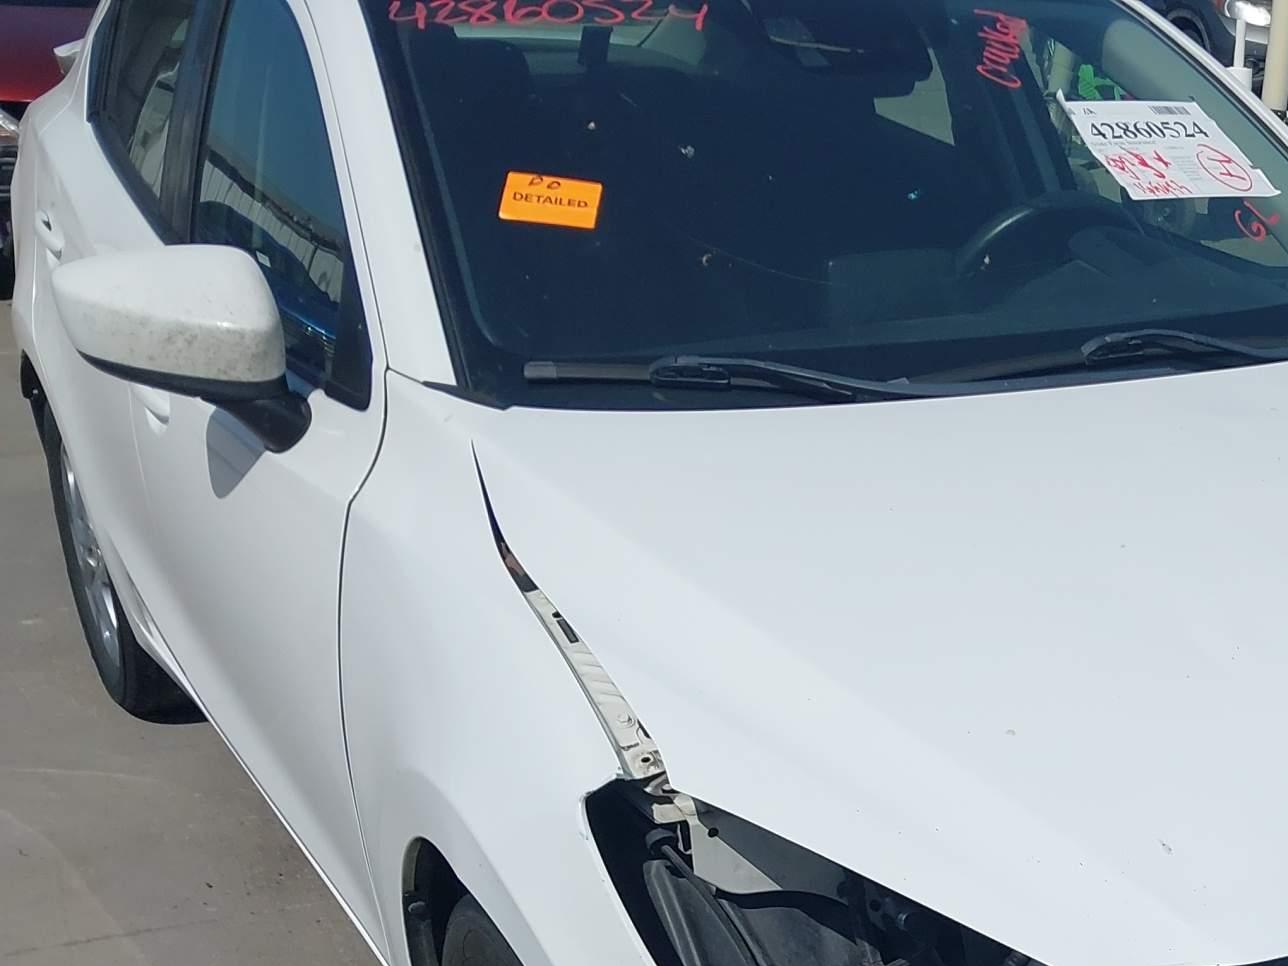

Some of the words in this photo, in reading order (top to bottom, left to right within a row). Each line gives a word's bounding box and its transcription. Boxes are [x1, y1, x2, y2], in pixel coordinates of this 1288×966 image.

[388, 0, 709, 30] 42860524
[1090, 121, 1210, 140] 42860524
[512, 191, 588, 208] DETAILED
